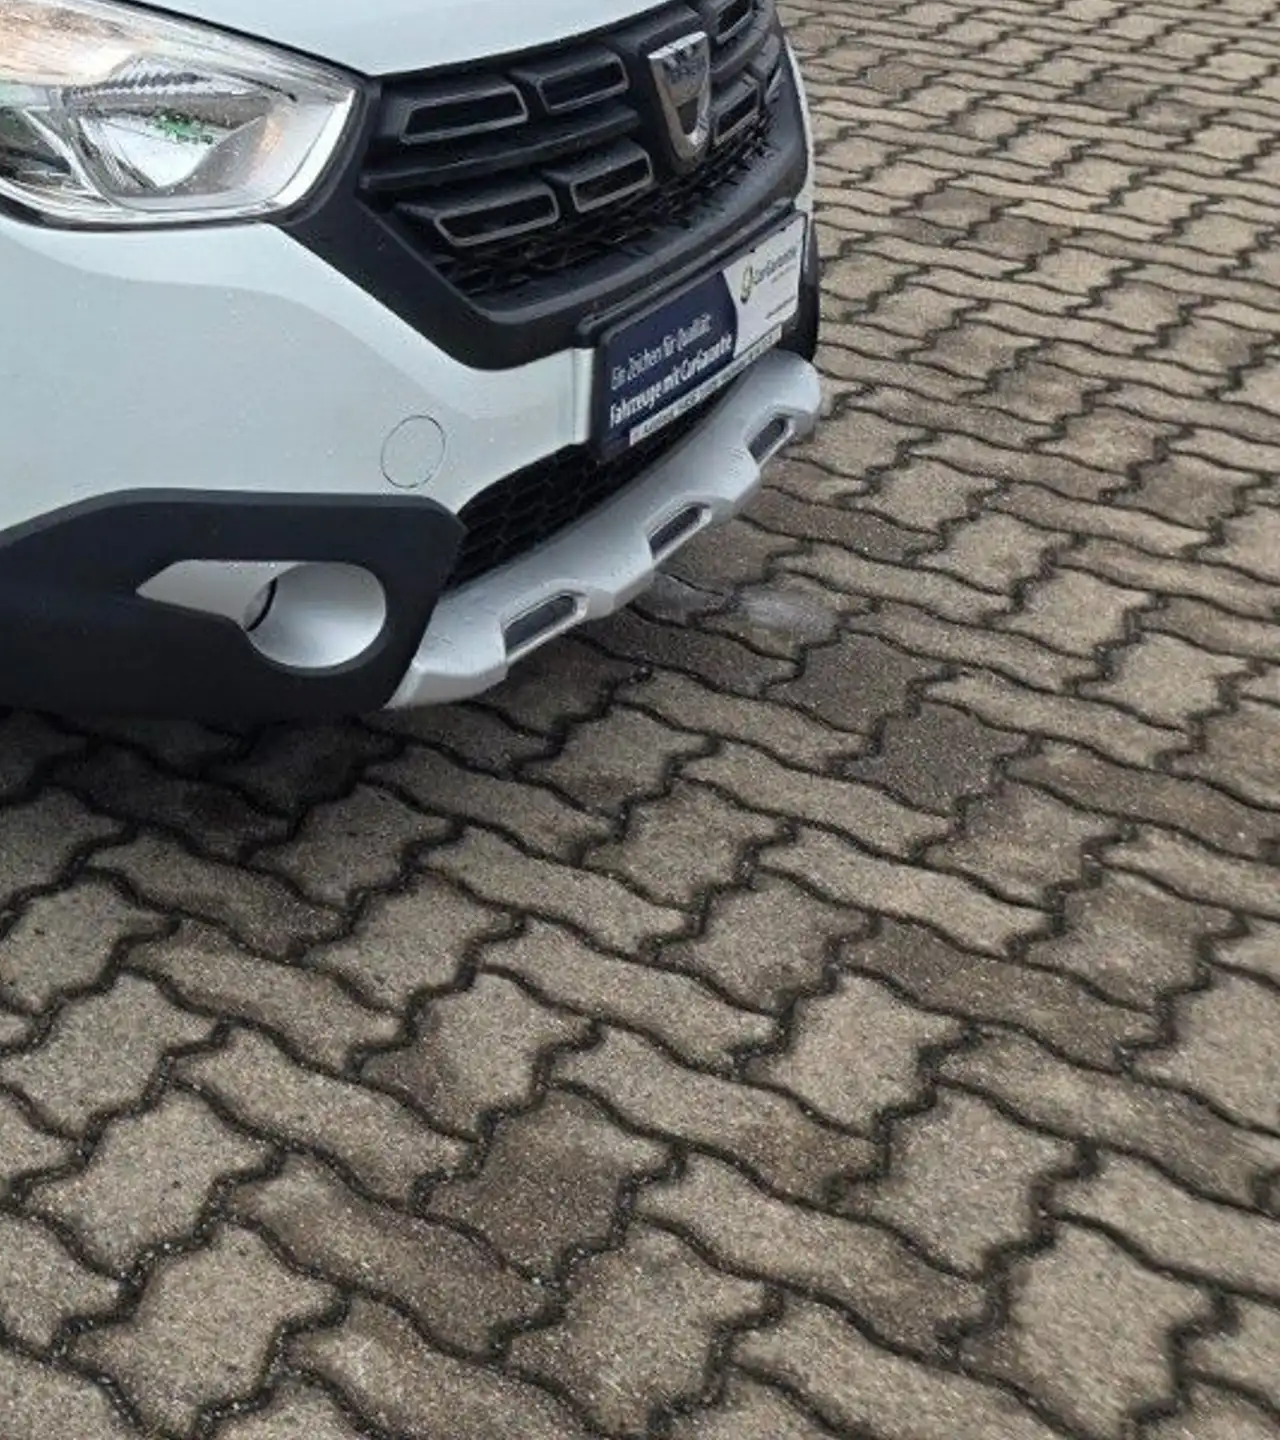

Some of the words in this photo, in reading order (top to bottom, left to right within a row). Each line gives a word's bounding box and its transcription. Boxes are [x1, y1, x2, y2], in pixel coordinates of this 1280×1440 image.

[609, 382, 661, 429] Fahrzeuge
[662, 365, 680, 393] mit
[680, 333, 732, 381] CarGarantie
[611, 365, 626, 391] Ein
[627, 347, 662, 381] Zeichen
[663, 334, 676, 358] für
